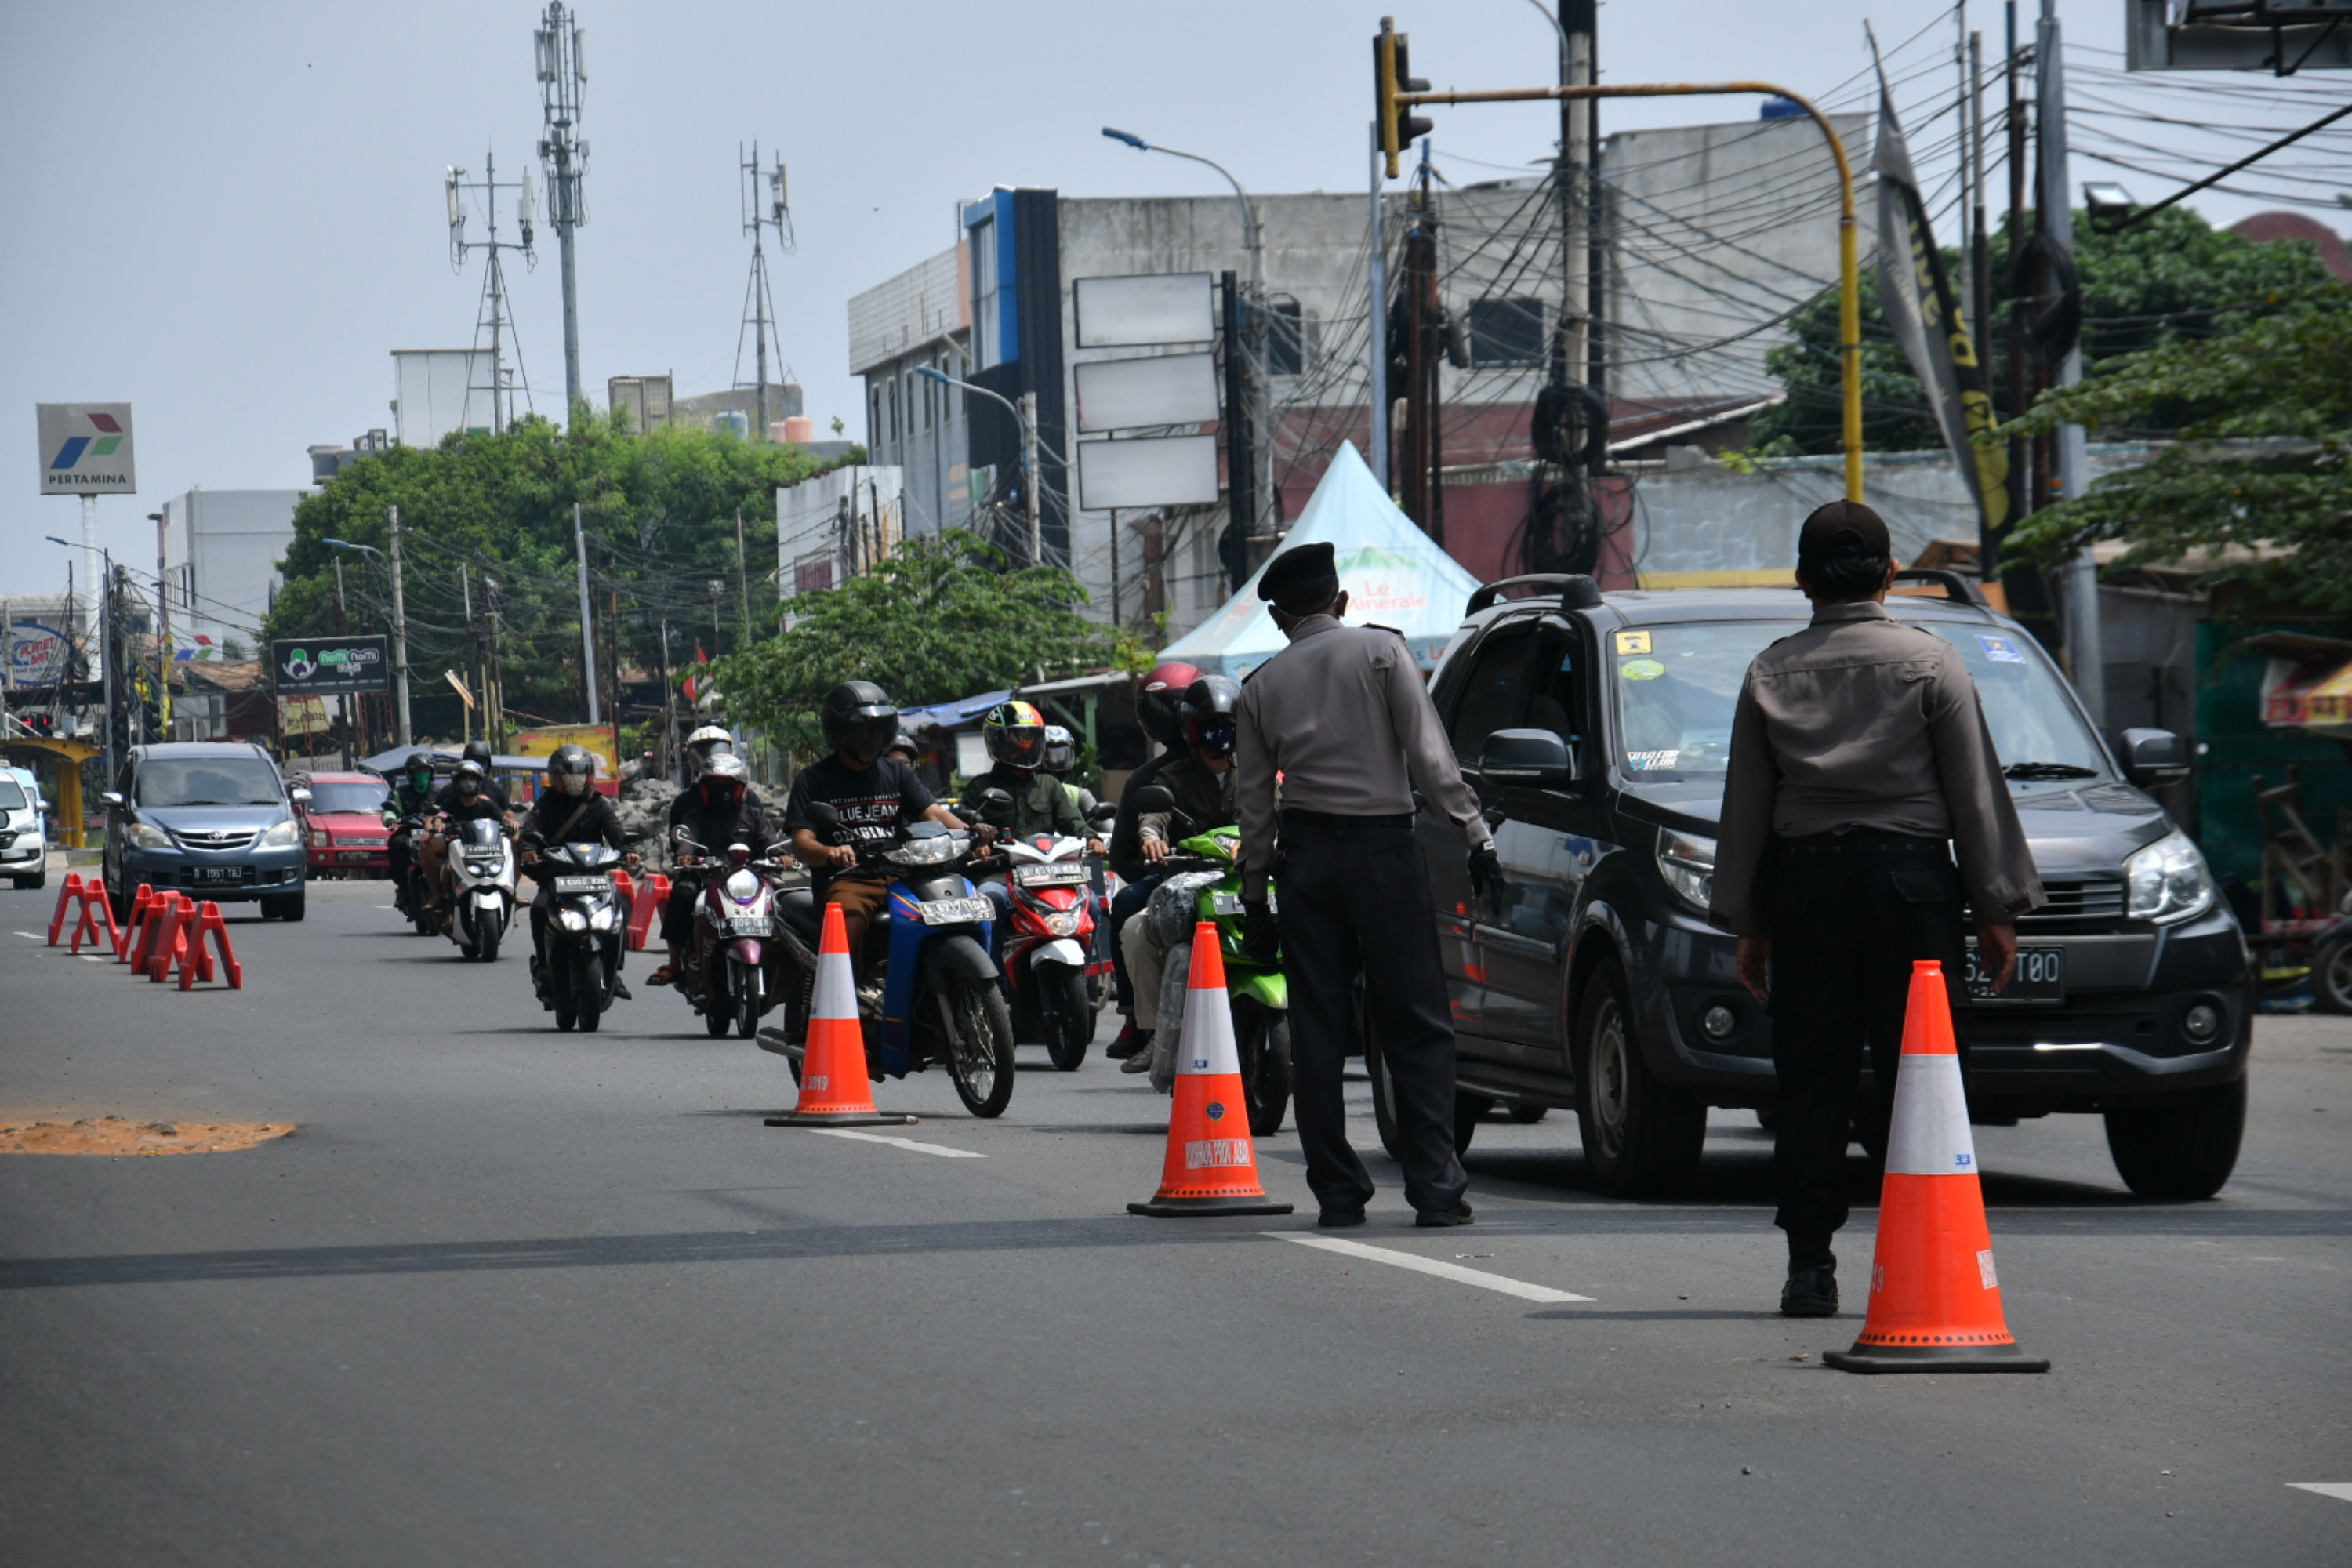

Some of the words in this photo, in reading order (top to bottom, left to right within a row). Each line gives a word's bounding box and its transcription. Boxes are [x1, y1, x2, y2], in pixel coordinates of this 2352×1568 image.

[49, 474, 126, 484] PERTAMINA
[1364, 579, 1390, 597] Le
[839, 805, 863, 822] LUE
